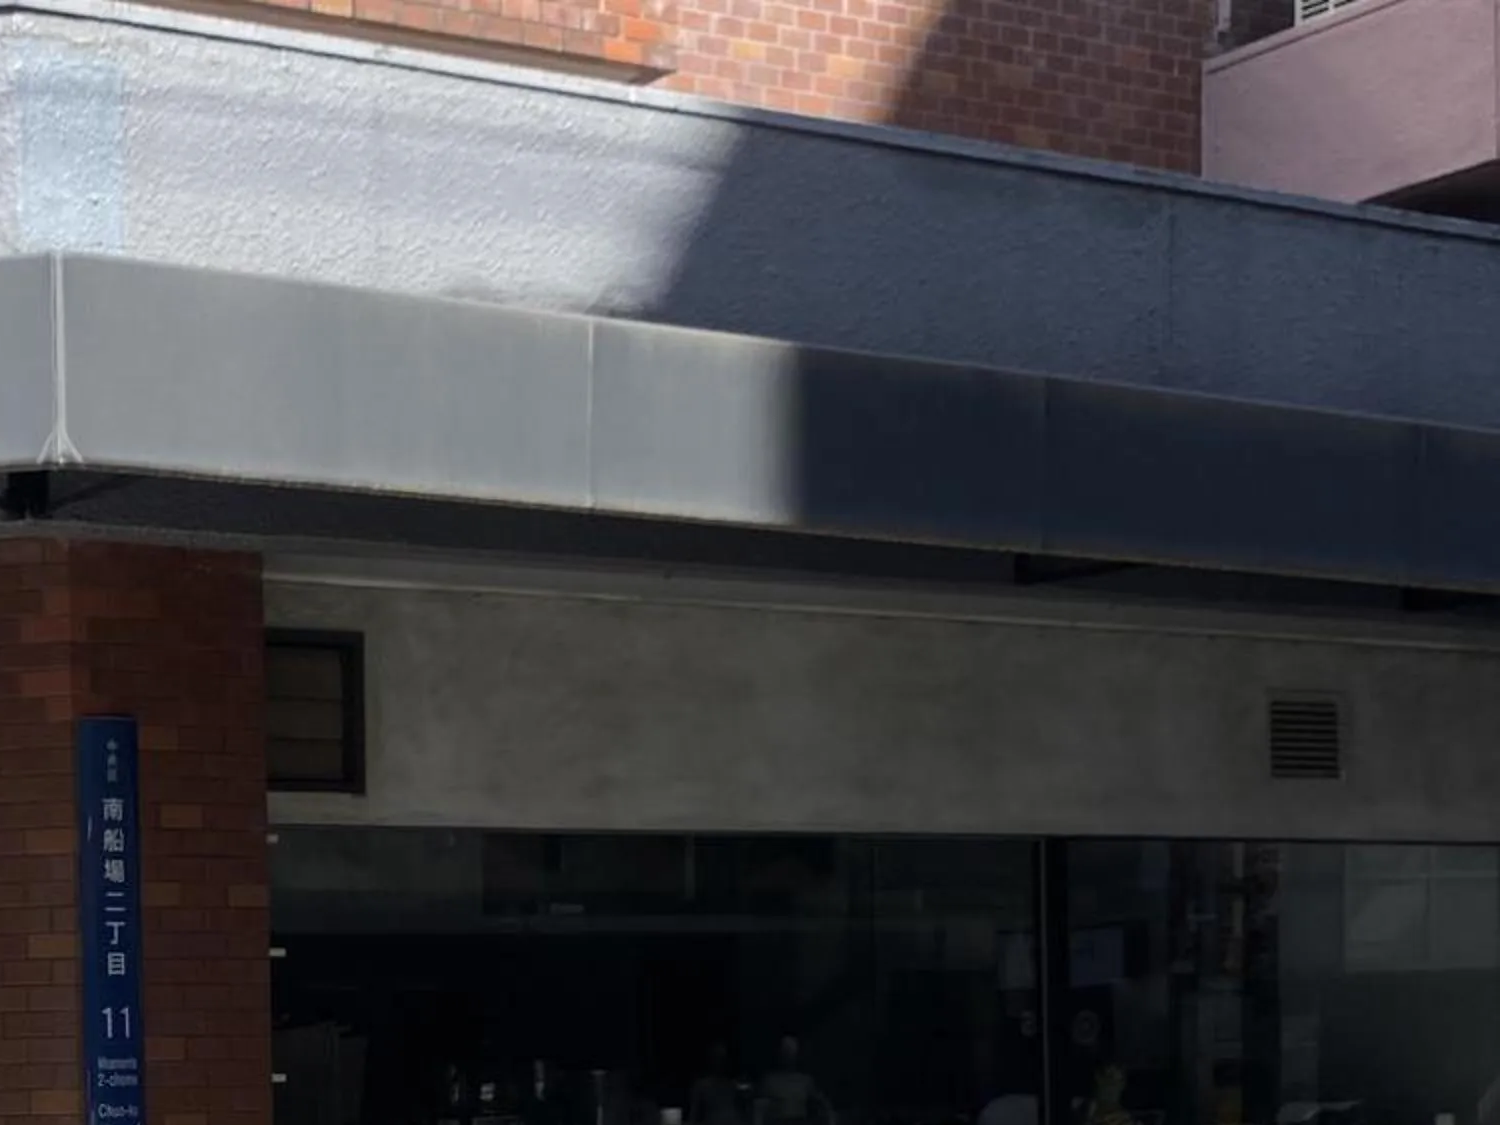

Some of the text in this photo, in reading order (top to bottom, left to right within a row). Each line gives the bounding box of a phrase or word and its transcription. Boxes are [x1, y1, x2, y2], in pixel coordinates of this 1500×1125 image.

[102, 798, 126, 976] 南船場二丁目
[101, 1007, 131, 1039] 11
